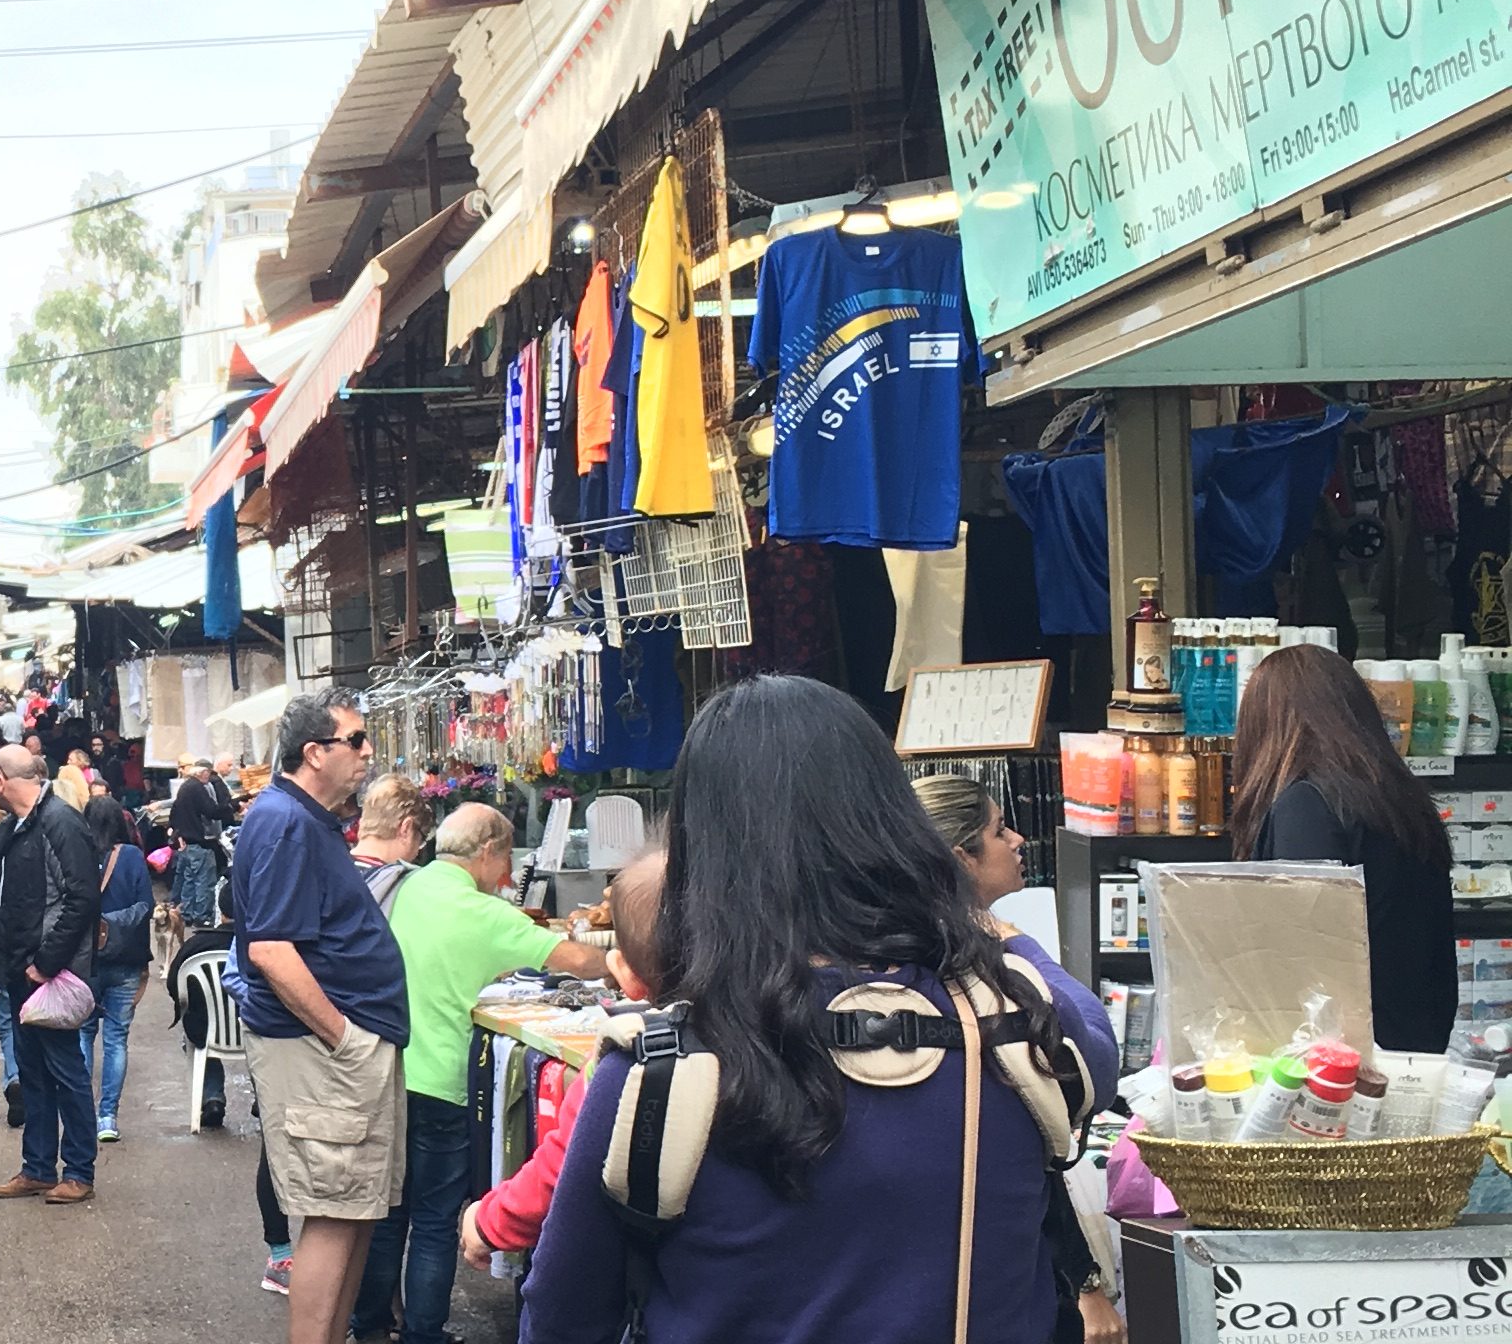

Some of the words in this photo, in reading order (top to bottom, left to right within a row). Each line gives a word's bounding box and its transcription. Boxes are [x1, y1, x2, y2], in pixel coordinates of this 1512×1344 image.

[963, 77, 998, 148] TAX
[994, 10, 1037, 103] FREE
[1386, 37, 1477, 114] HaCarmel
[1479, 28, 1504, 67] st.
[1033, 92, 1203, 242] КОСМЕТИКА
[1261, 143, 1281, 179] Fri
[1282, 101, 1360, 167] 9:00-15:00
[1123, 222, 1145, 248] Sun
[1152, 203, 1176, 233] Thu
[1177, 183, 1204, 223] 9:00
[1213, 161, 1246, 202] 18:00
[1027, 273, 1043, 302] AVI
[1044, 238, 1107, 292] 050-5364873
[817, 353, 900, 441] ISRAEL
[1287, 1331, 1329, 1344] DEAD
[1336, 1329, 1364, 1342] SEA
[1370, 1325, 1459, 1340] TREATMENT
[1307, 1296, 1350, 1328] of
